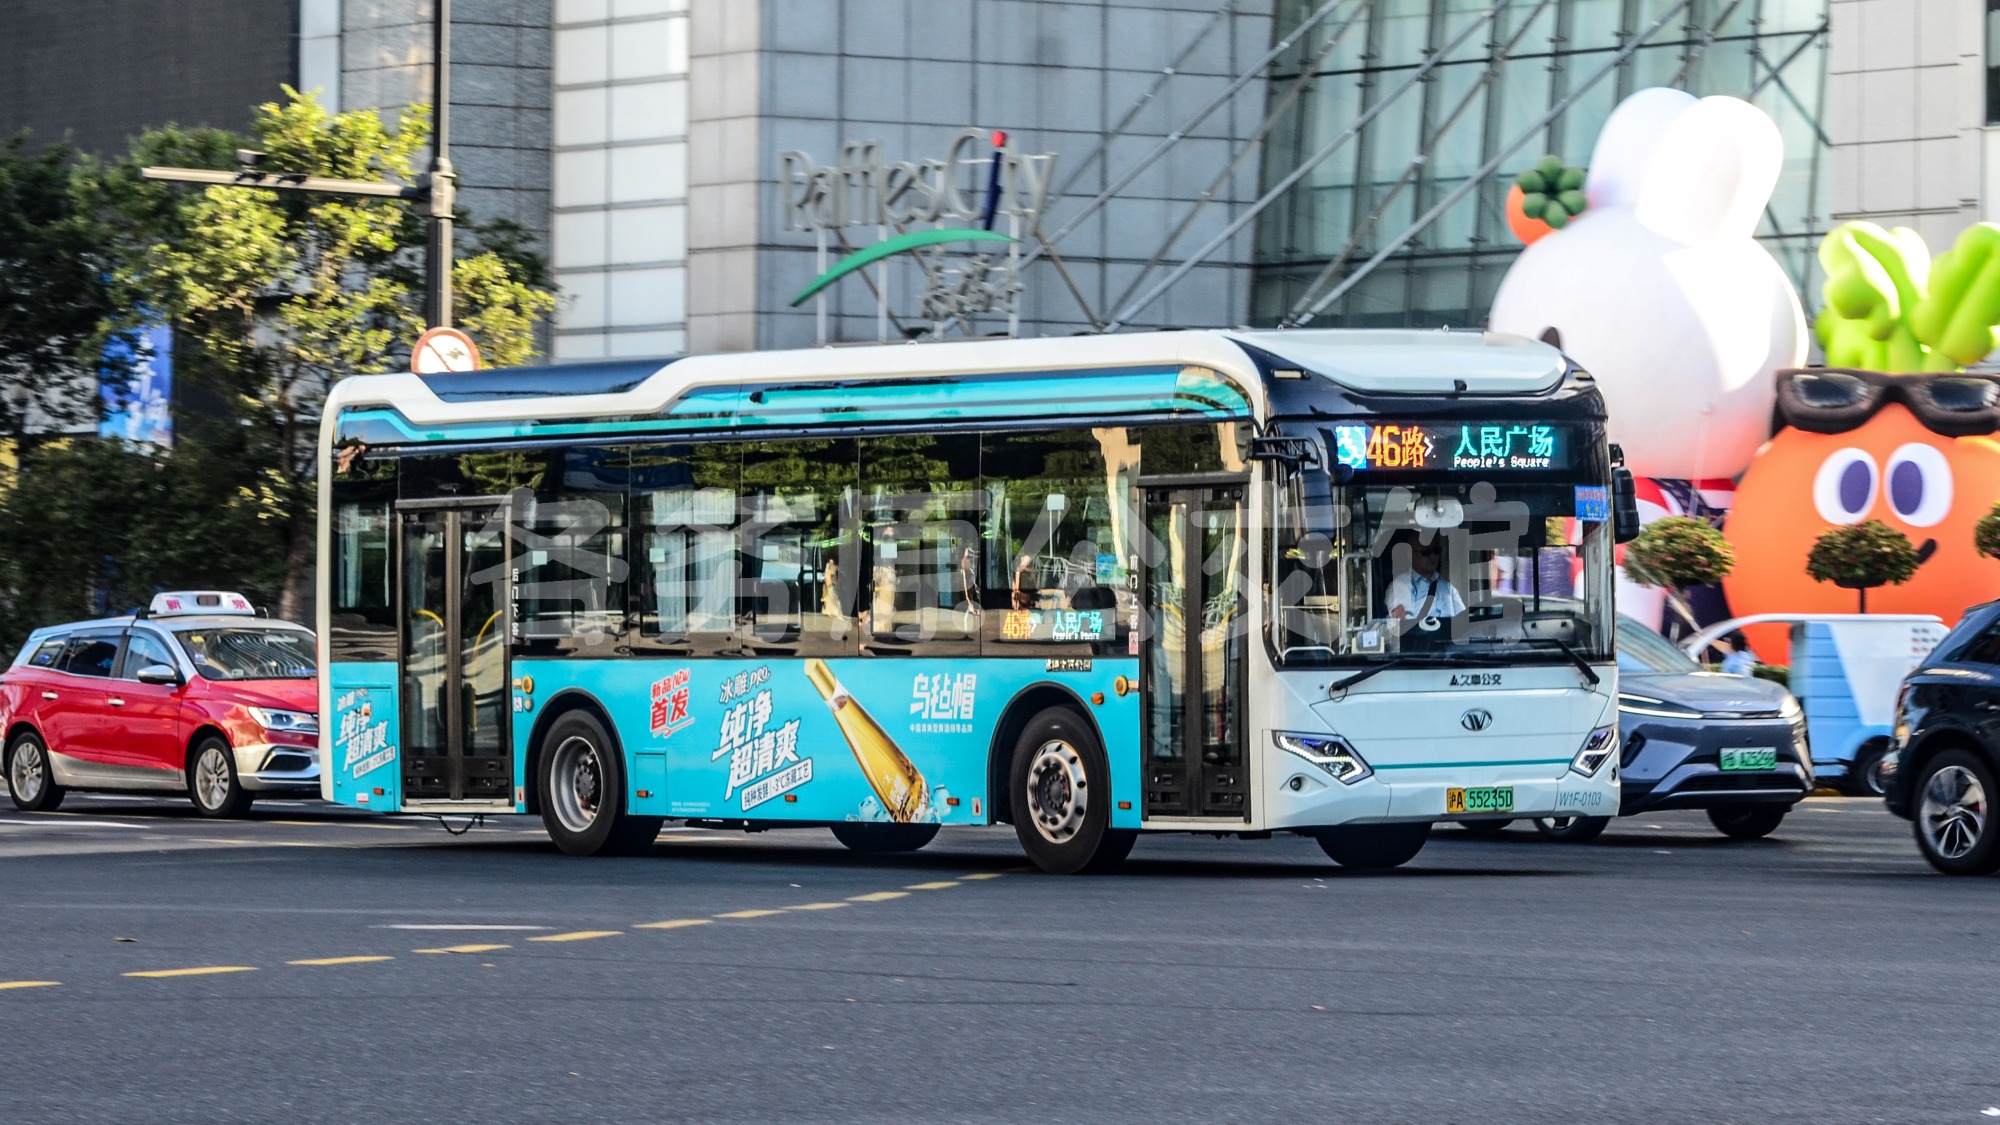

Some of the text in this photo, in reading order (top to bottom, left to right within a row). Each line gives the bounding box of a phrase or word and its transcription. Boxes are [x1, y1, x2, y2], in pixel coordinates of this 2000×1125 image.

[1366, 425, 1426, 467] 46路
[1454, 425, 1554, 457] 人民广场
[1453, 456, 1549, 469] People's Square
[1052, 610, 1103, 634] 人民广场
[651, 688, 689, 731] 首发
[909, 673, 977, 719] 乌毡帽
[712, 689, 772, 762] 纯净
[724, 719, 801, 801] 超清爽
[1559, 792, 1602, 806] W1F-0103
